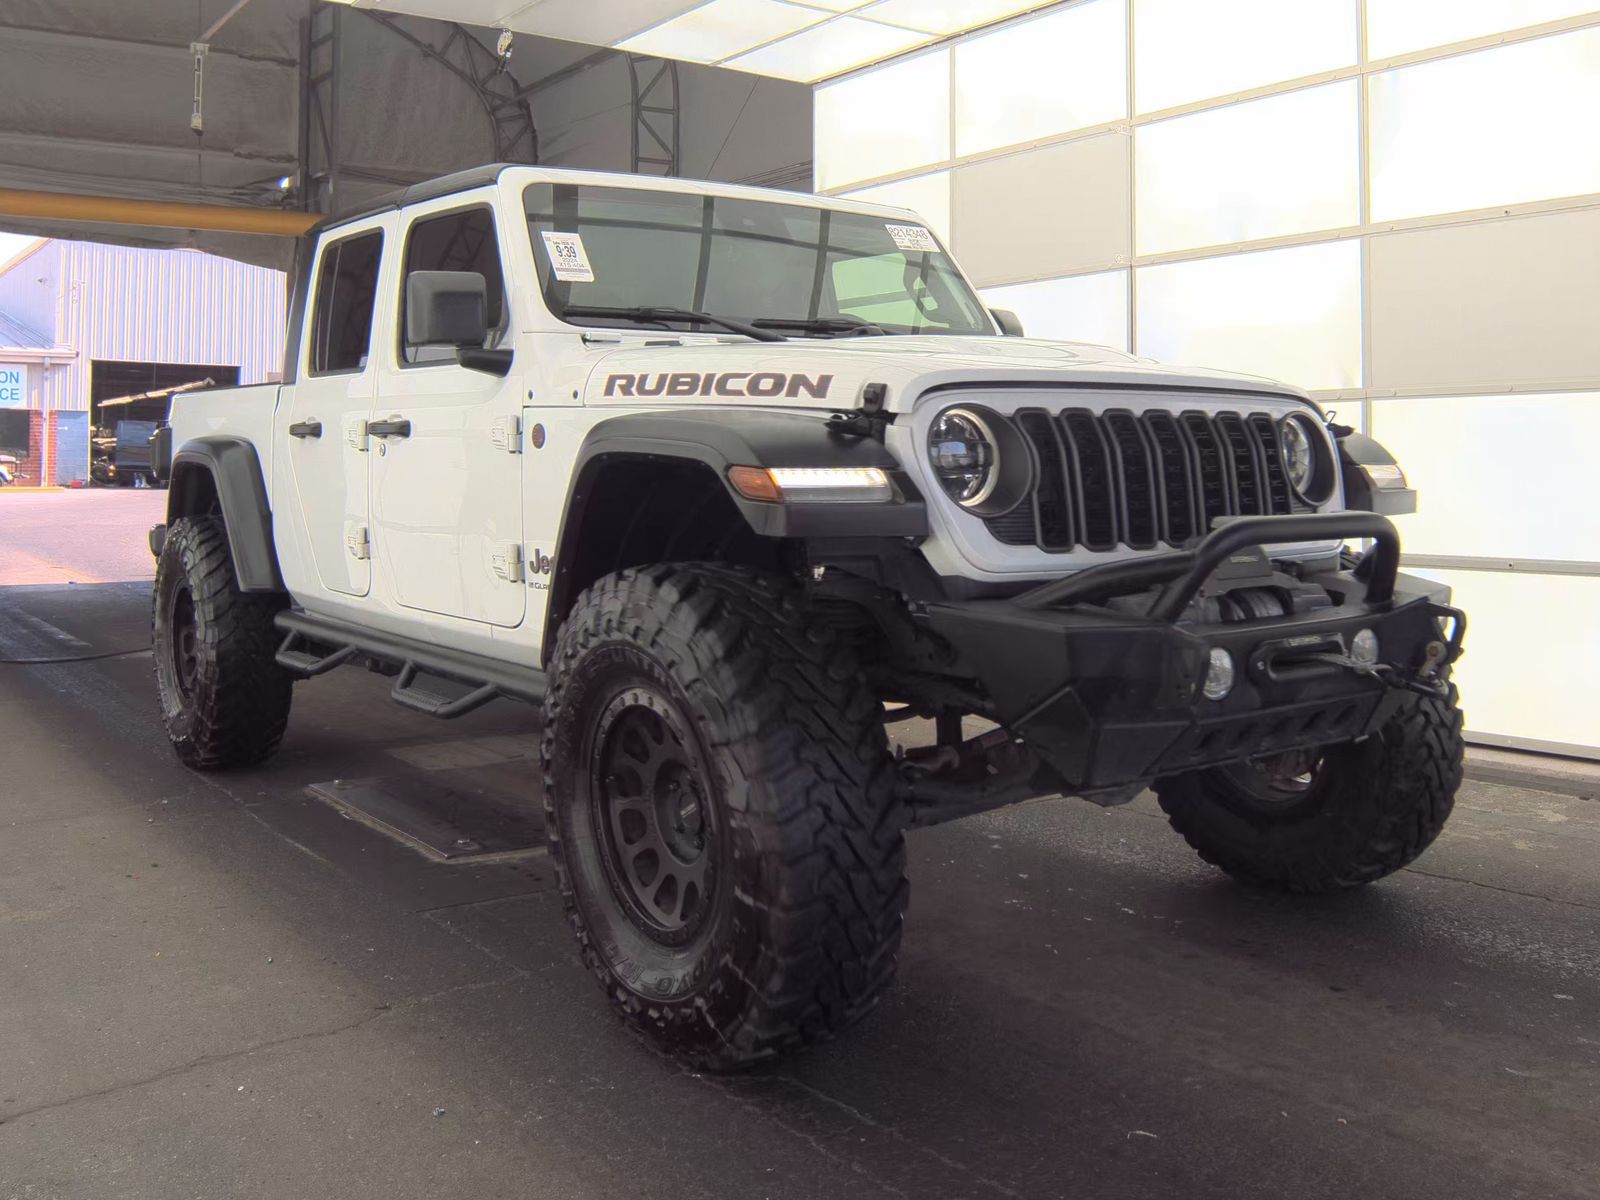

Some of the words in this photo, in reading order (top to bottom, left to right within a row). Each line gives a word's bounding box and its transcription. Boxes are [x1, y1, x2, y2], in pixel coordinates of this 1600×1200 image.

[556, 245, 576, 257] 9:39
[0, 371, 19, 384] ON
[603, 373, 834, 399] RUBICON
[0, 388, 19, 400] CE
